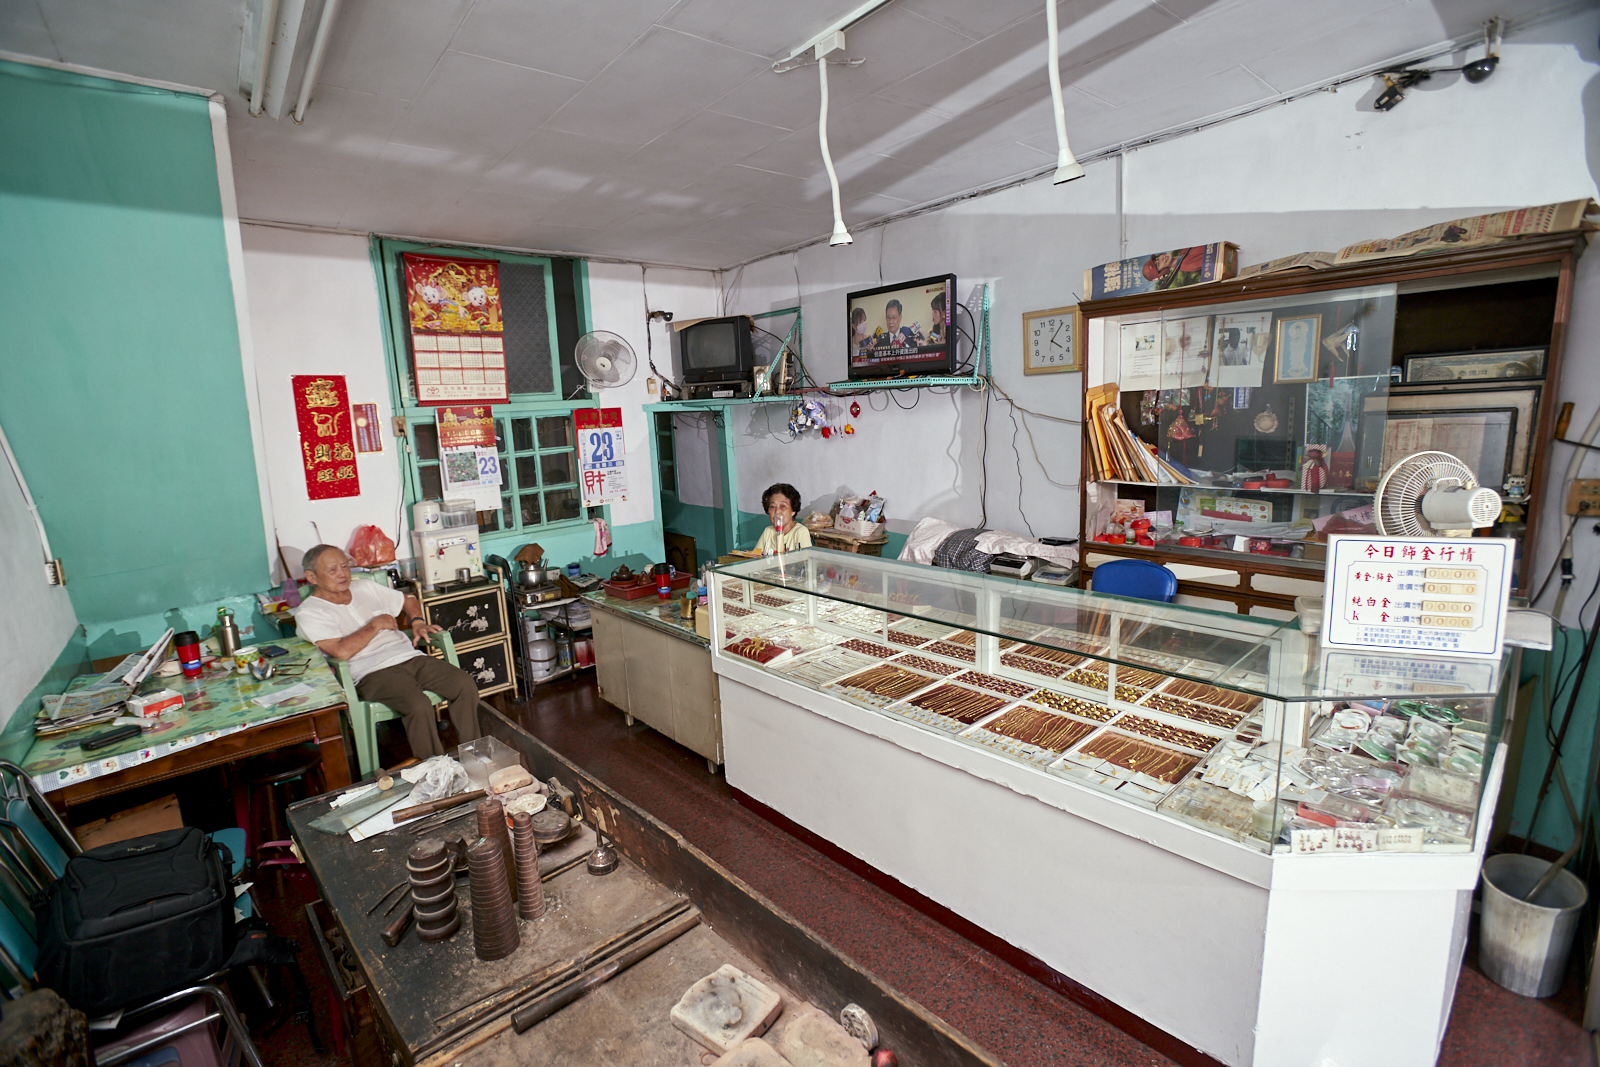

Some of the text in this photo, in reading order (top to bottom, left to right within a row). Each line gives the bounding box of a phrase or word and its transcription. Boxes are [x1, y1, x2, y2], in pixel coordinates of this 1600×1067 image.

[1104, 261, 1121, 293] 強棒
[1133, 271, 1142, 287] HOME
[590, 432, 614, 462] 23
[479, 456, 497, 475] 23
[584, 470, 606, 496] 財
[1364, 544, 1476, 562] 今日飾金行情
[1352, 596, 1391, 608] 純白金
